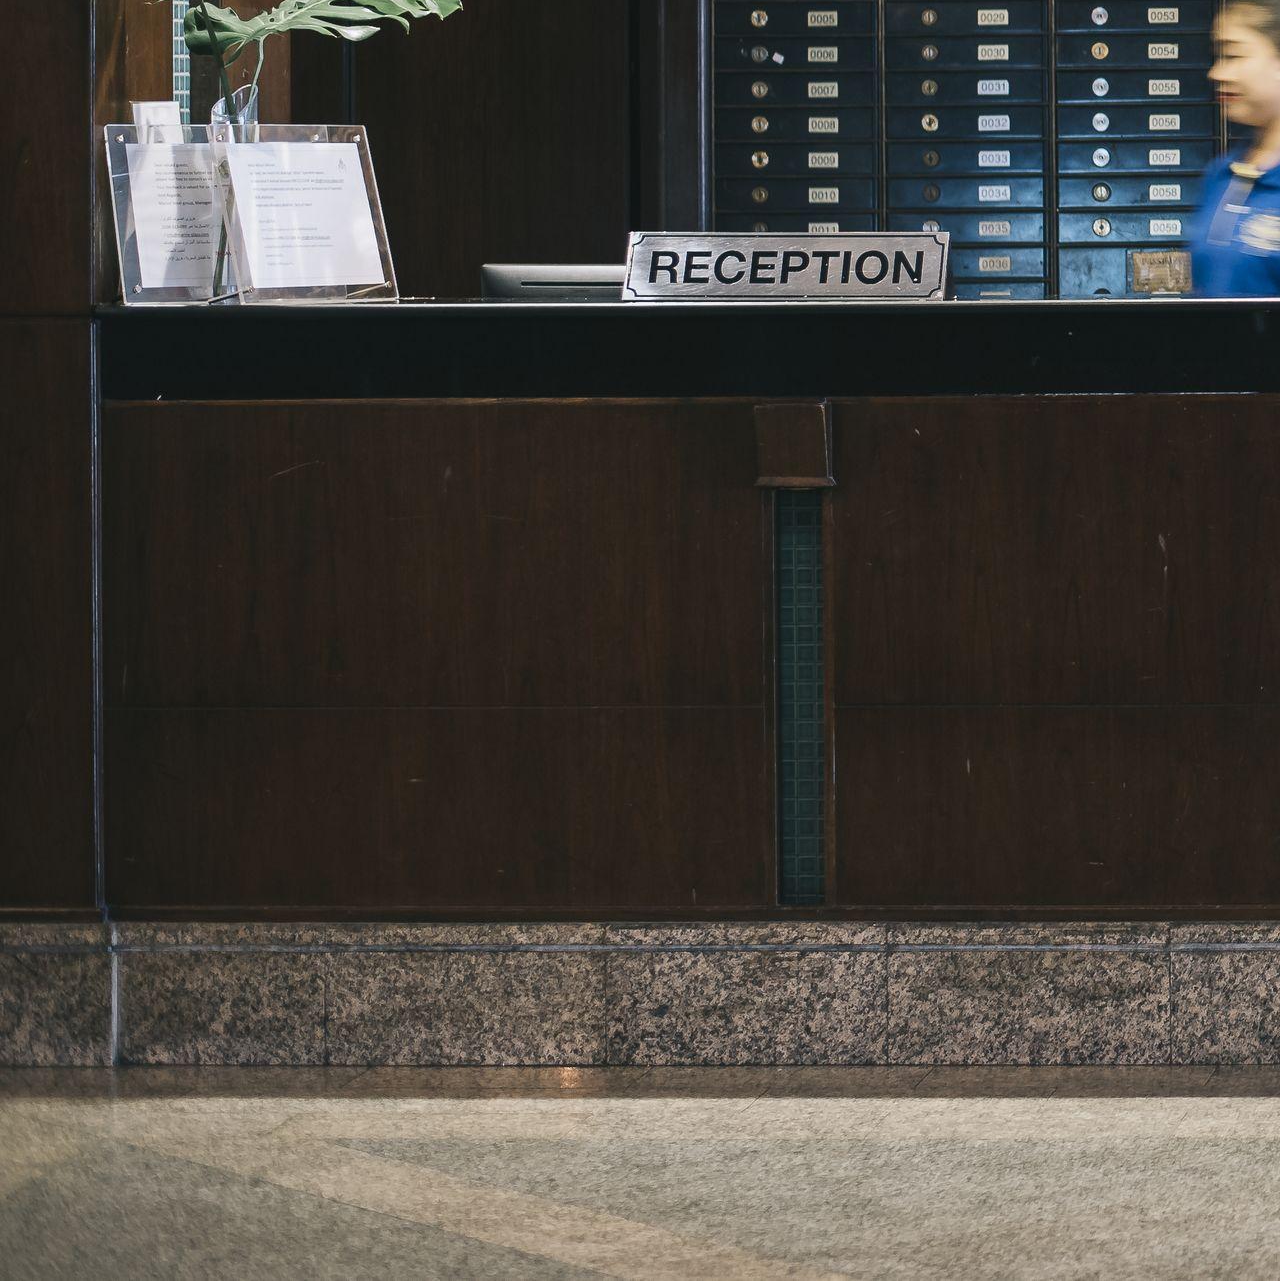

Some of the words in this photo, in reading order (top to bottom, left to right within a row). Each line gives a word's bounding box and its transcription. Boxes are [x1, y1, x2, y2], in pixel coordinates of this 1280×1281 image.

[810, 14, 835, 24] 0005
[980, 13, 1005, 22] 0029
[1150, 11, 1175, 21] 0053
[810, 50, 834, 60] 0006
[980, 48, 1005, 58] 0030
[1150, 46, 1175, 56] 0054
[810, 85, 835, 96] 0007
[981, 82, 1005, 92] 0031
[1151, 82, 1176, 92] 0055
[811, 120, 836, 130] 0008
[981, 118, 1006, 128] 0032
[1152, 117, 1176, 127] 0056
[811, 155, 836, 165] 0009
[981, 153, 1007, 163] 0033
[1152, 153, 1177, 162] 0057
[811, 191, 836, 201] 0010
[981, 188, 1007, 198] 0034
[1152, 187, 1177, 197] 0058
[981, 224, 1008, 233] 0035
[1153, 223, 1178, 233] 0059
[648, 250, 924, 285] RECEPTION
[981, 259, 1008, 270] 0036
